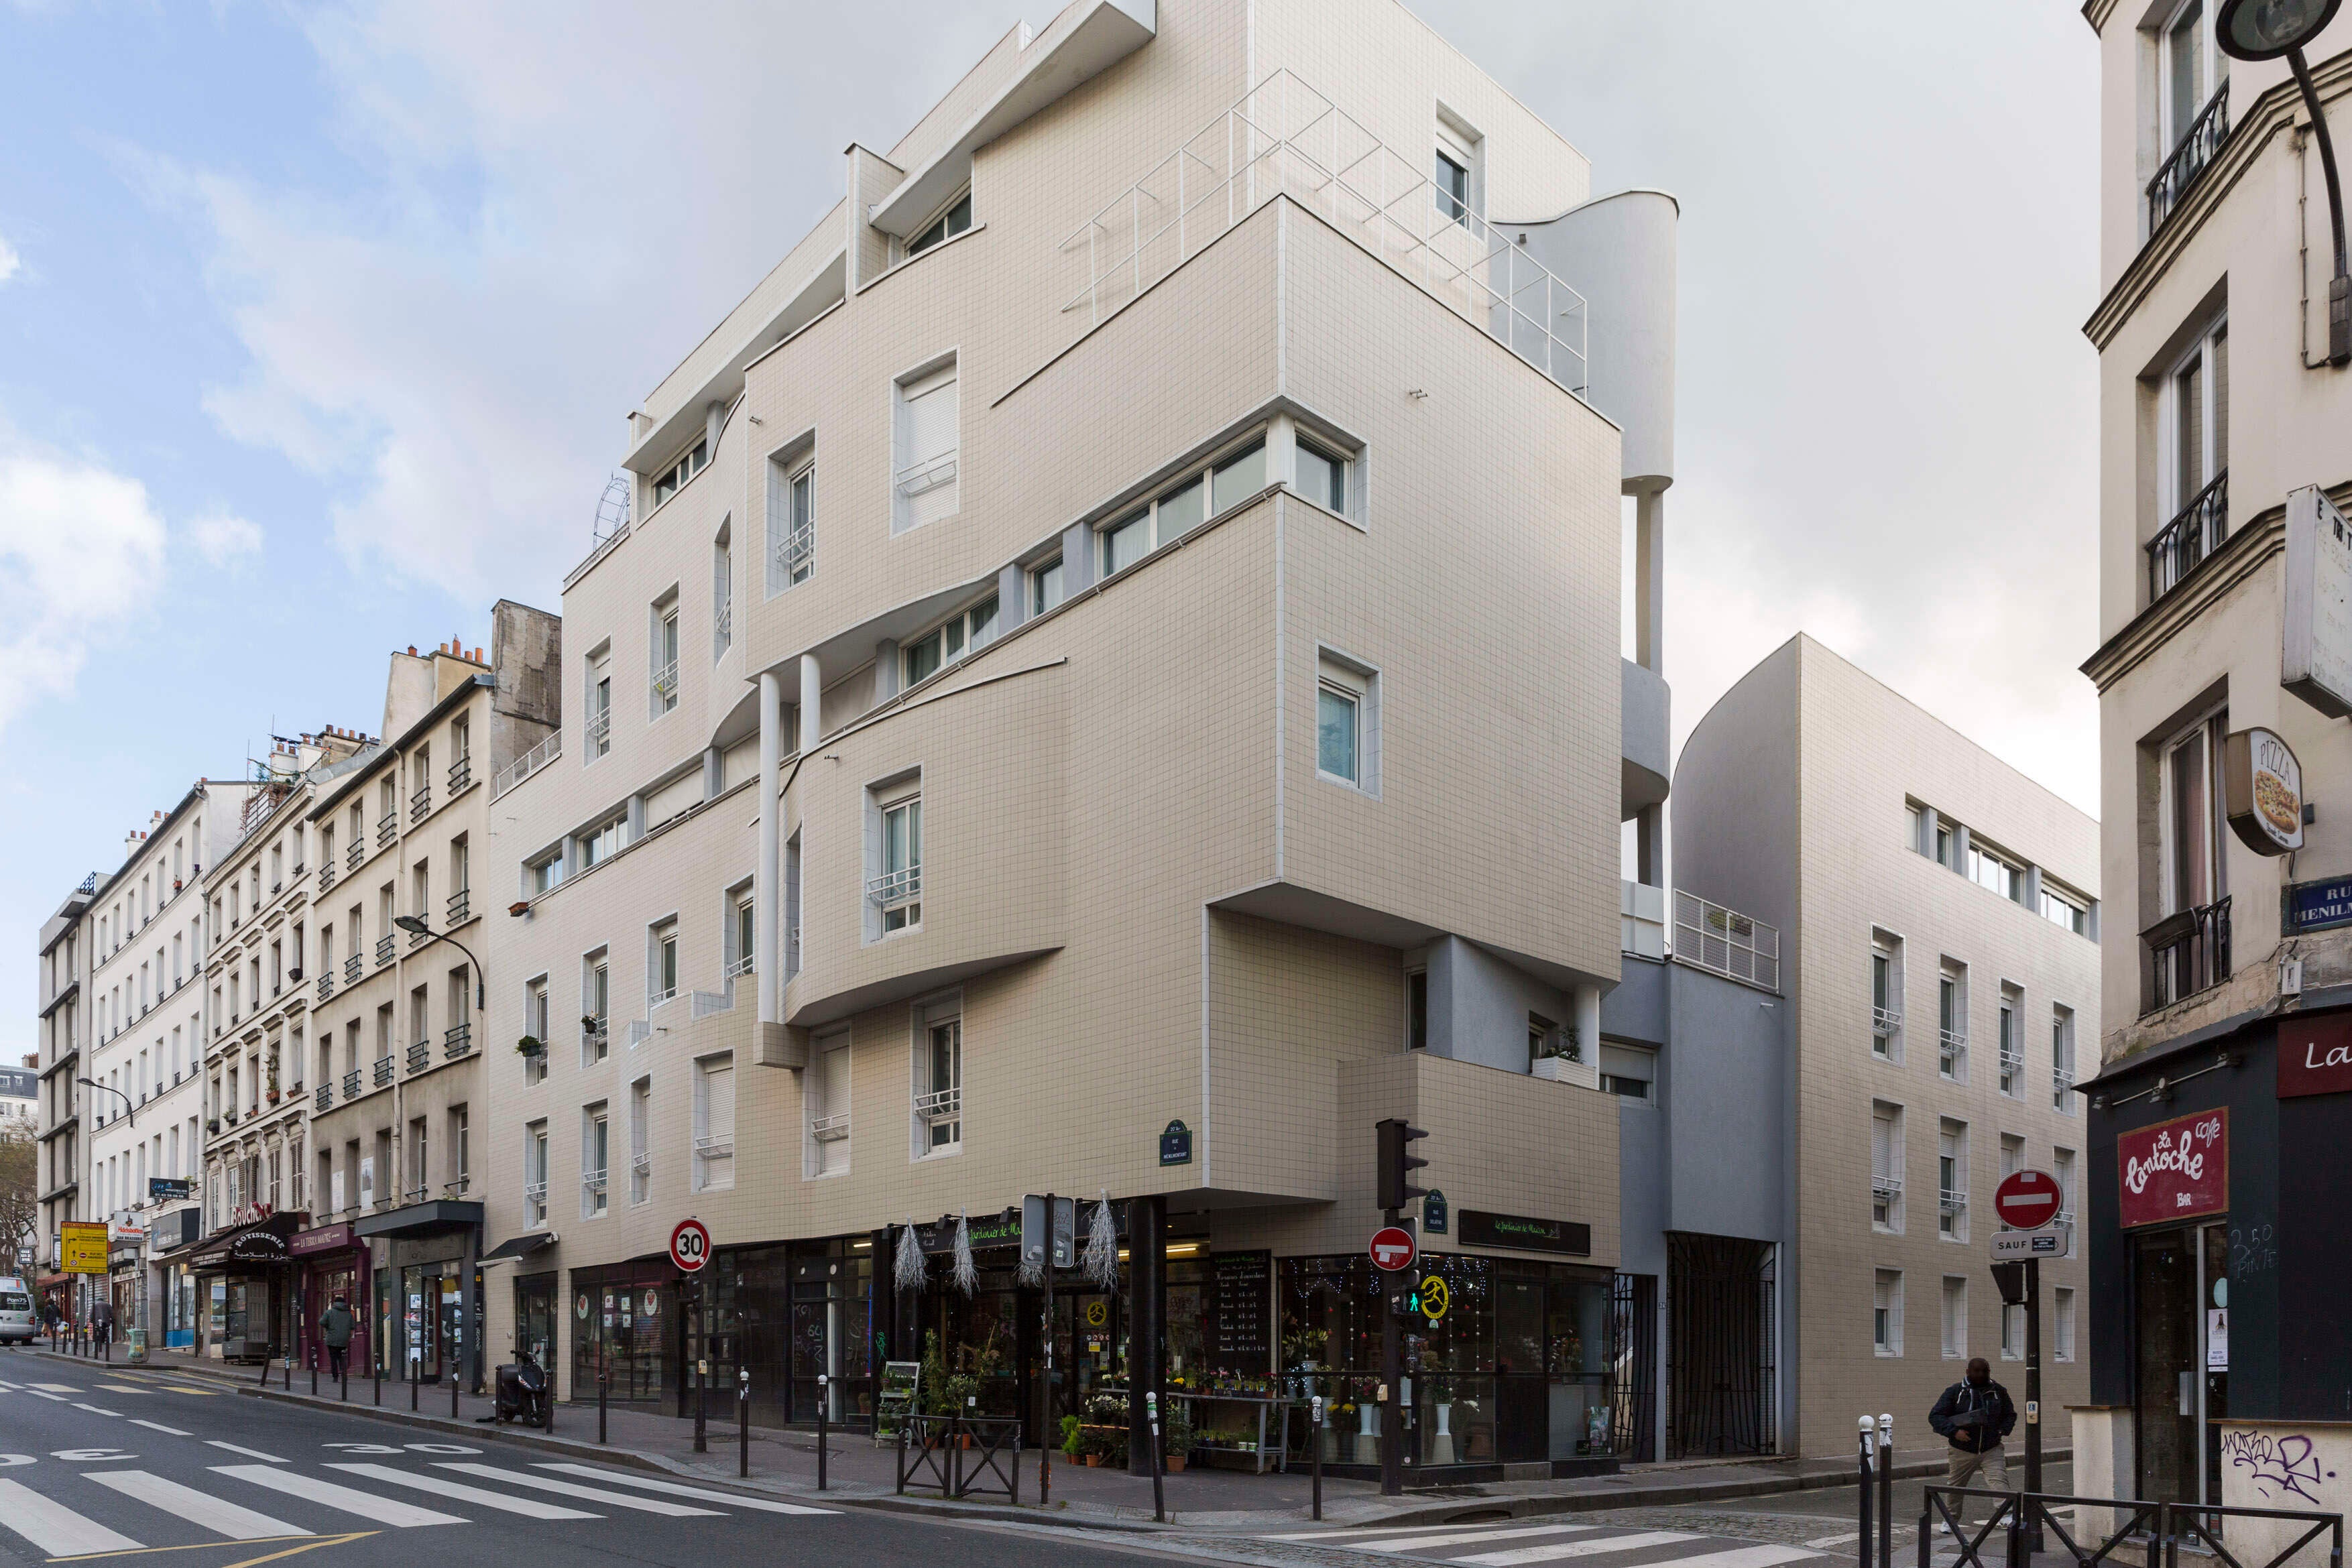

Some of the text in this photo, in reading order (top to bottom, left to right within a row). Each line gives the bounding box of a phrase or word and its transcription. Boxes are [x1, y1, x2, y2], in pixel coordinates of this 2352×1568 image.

[2260, 740, 2291, 785] PIZZA
[2306, 1042, 2352, 1069] La
[2176, 1193, 2191, 1207] BAR
[235, 1232, 285, 1248] ROTISSERIE
[679, 1233, 703, 1256] 30
[1998, 1240, 2027, 1250] SAUF
[322, 1443, 484, 1454] 30
